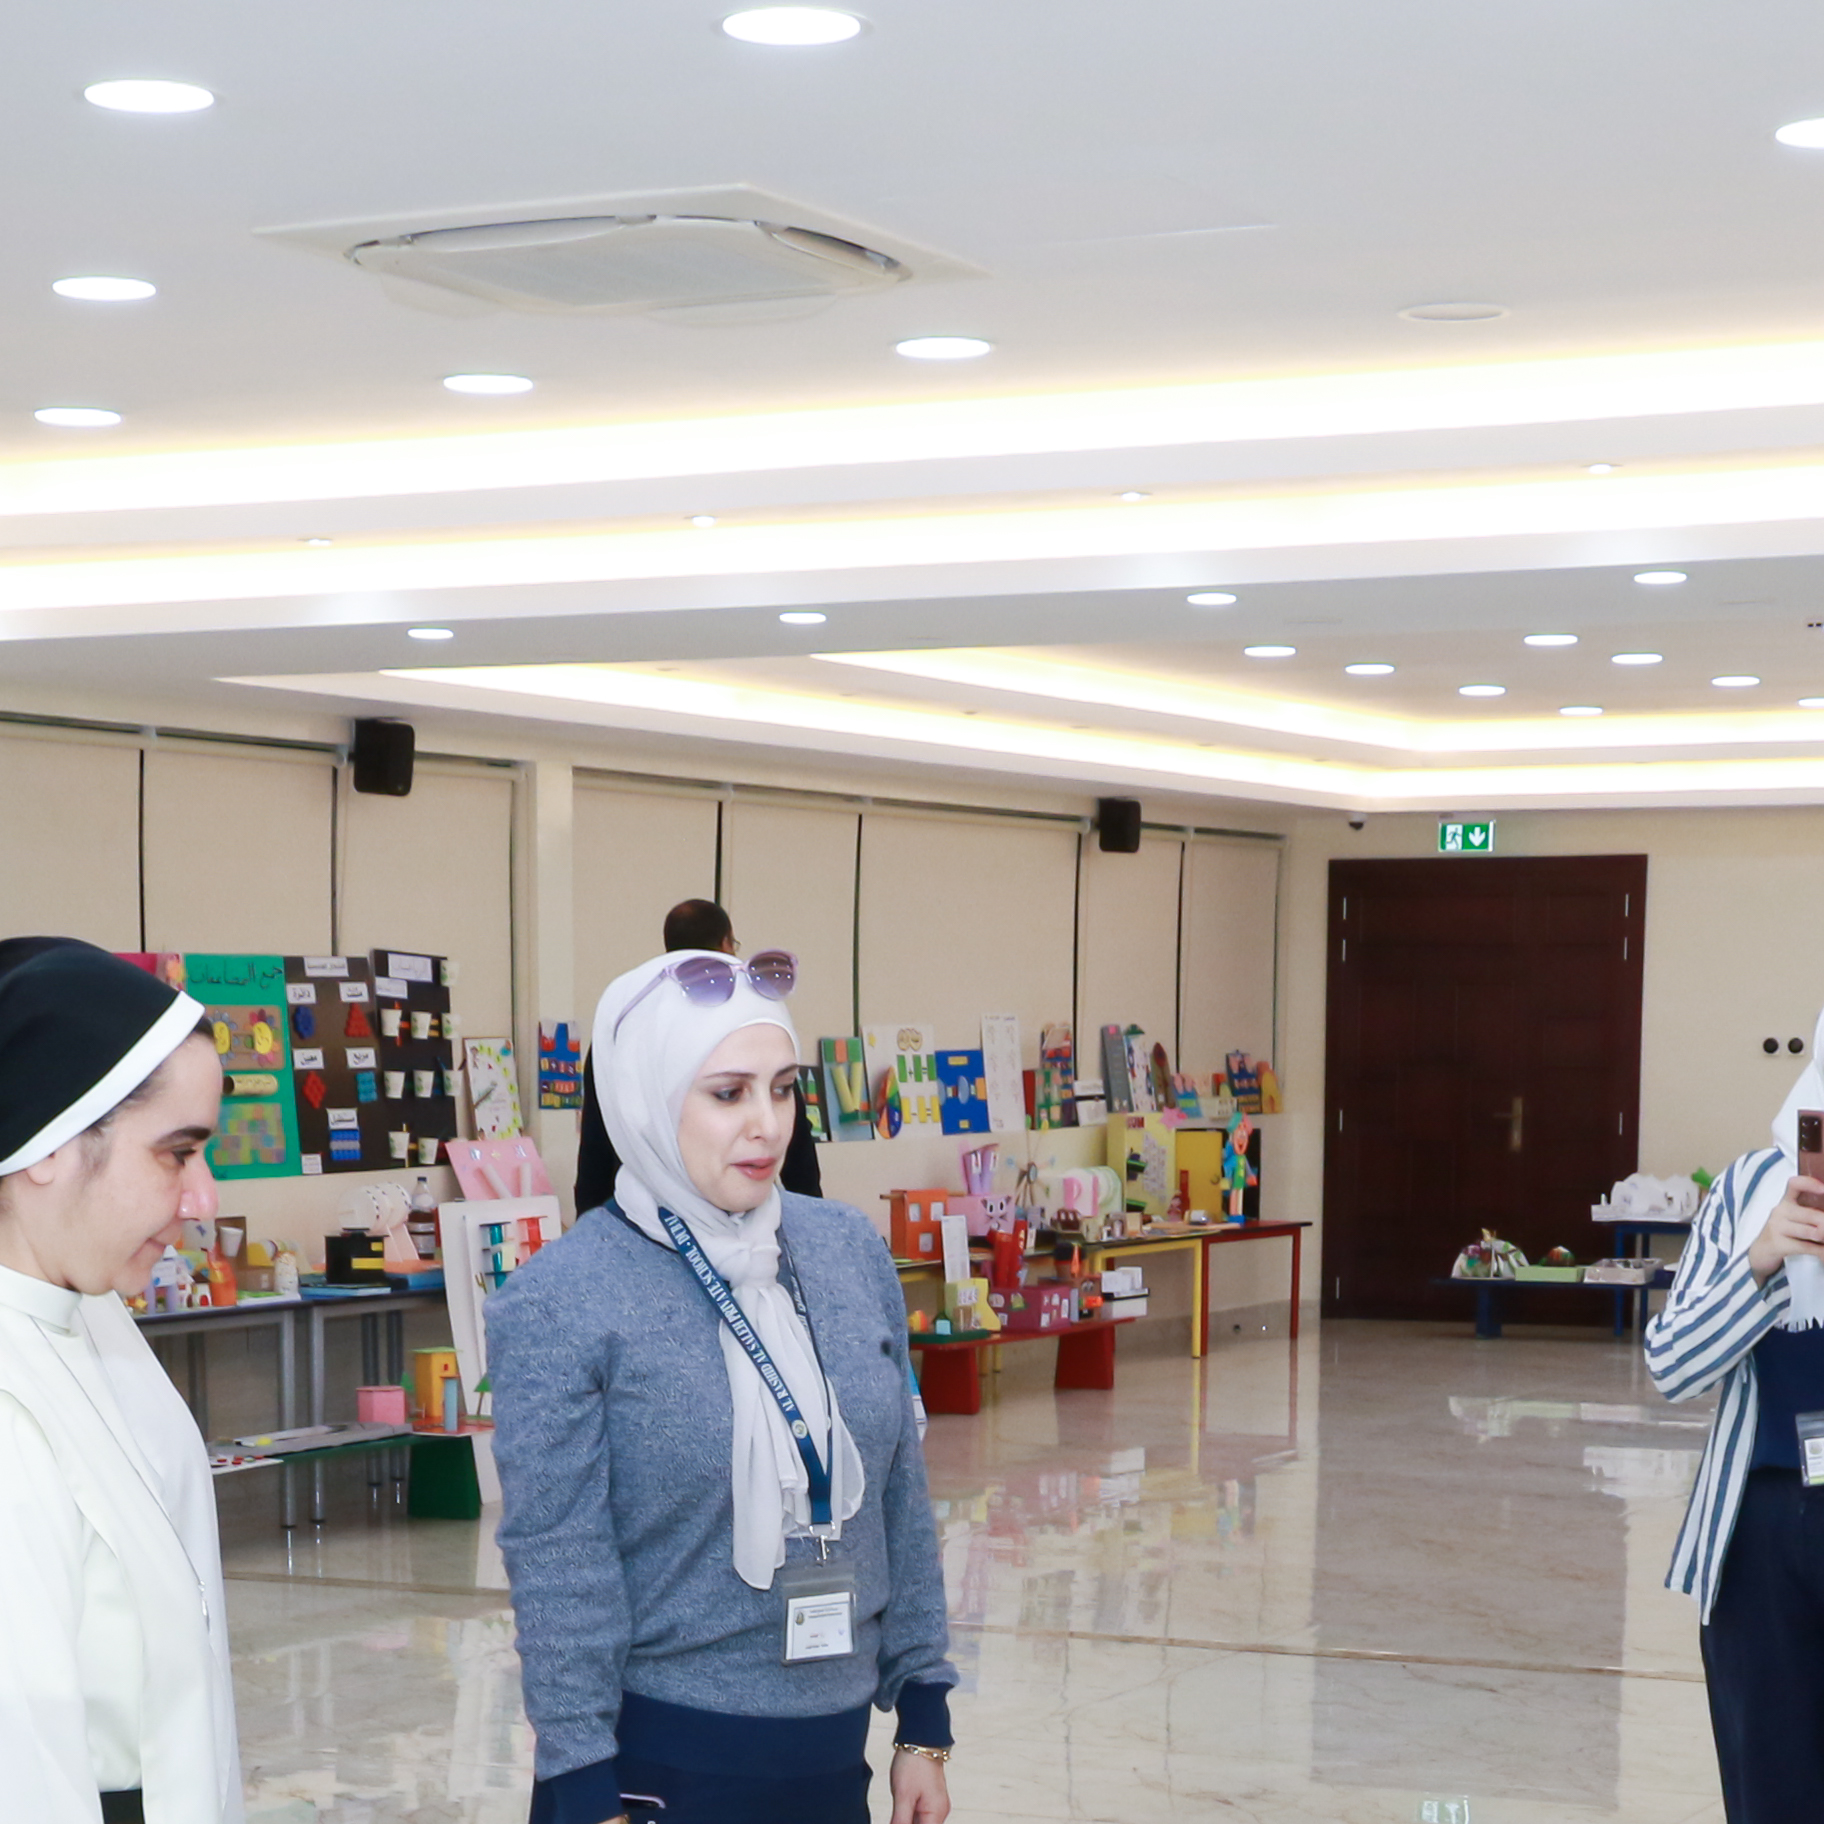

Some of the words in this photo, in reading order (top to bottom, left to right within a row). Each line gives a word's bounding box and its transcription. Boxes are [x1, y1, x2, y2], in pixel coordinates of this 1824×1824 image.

[685, 1244, 717, 1287] SCHOOL
[706, 1280, 742, 1325] PRIVATE
[732, 1319, 760, 1354] SALEH
[760, 1362, 790, 1400] RASHID
